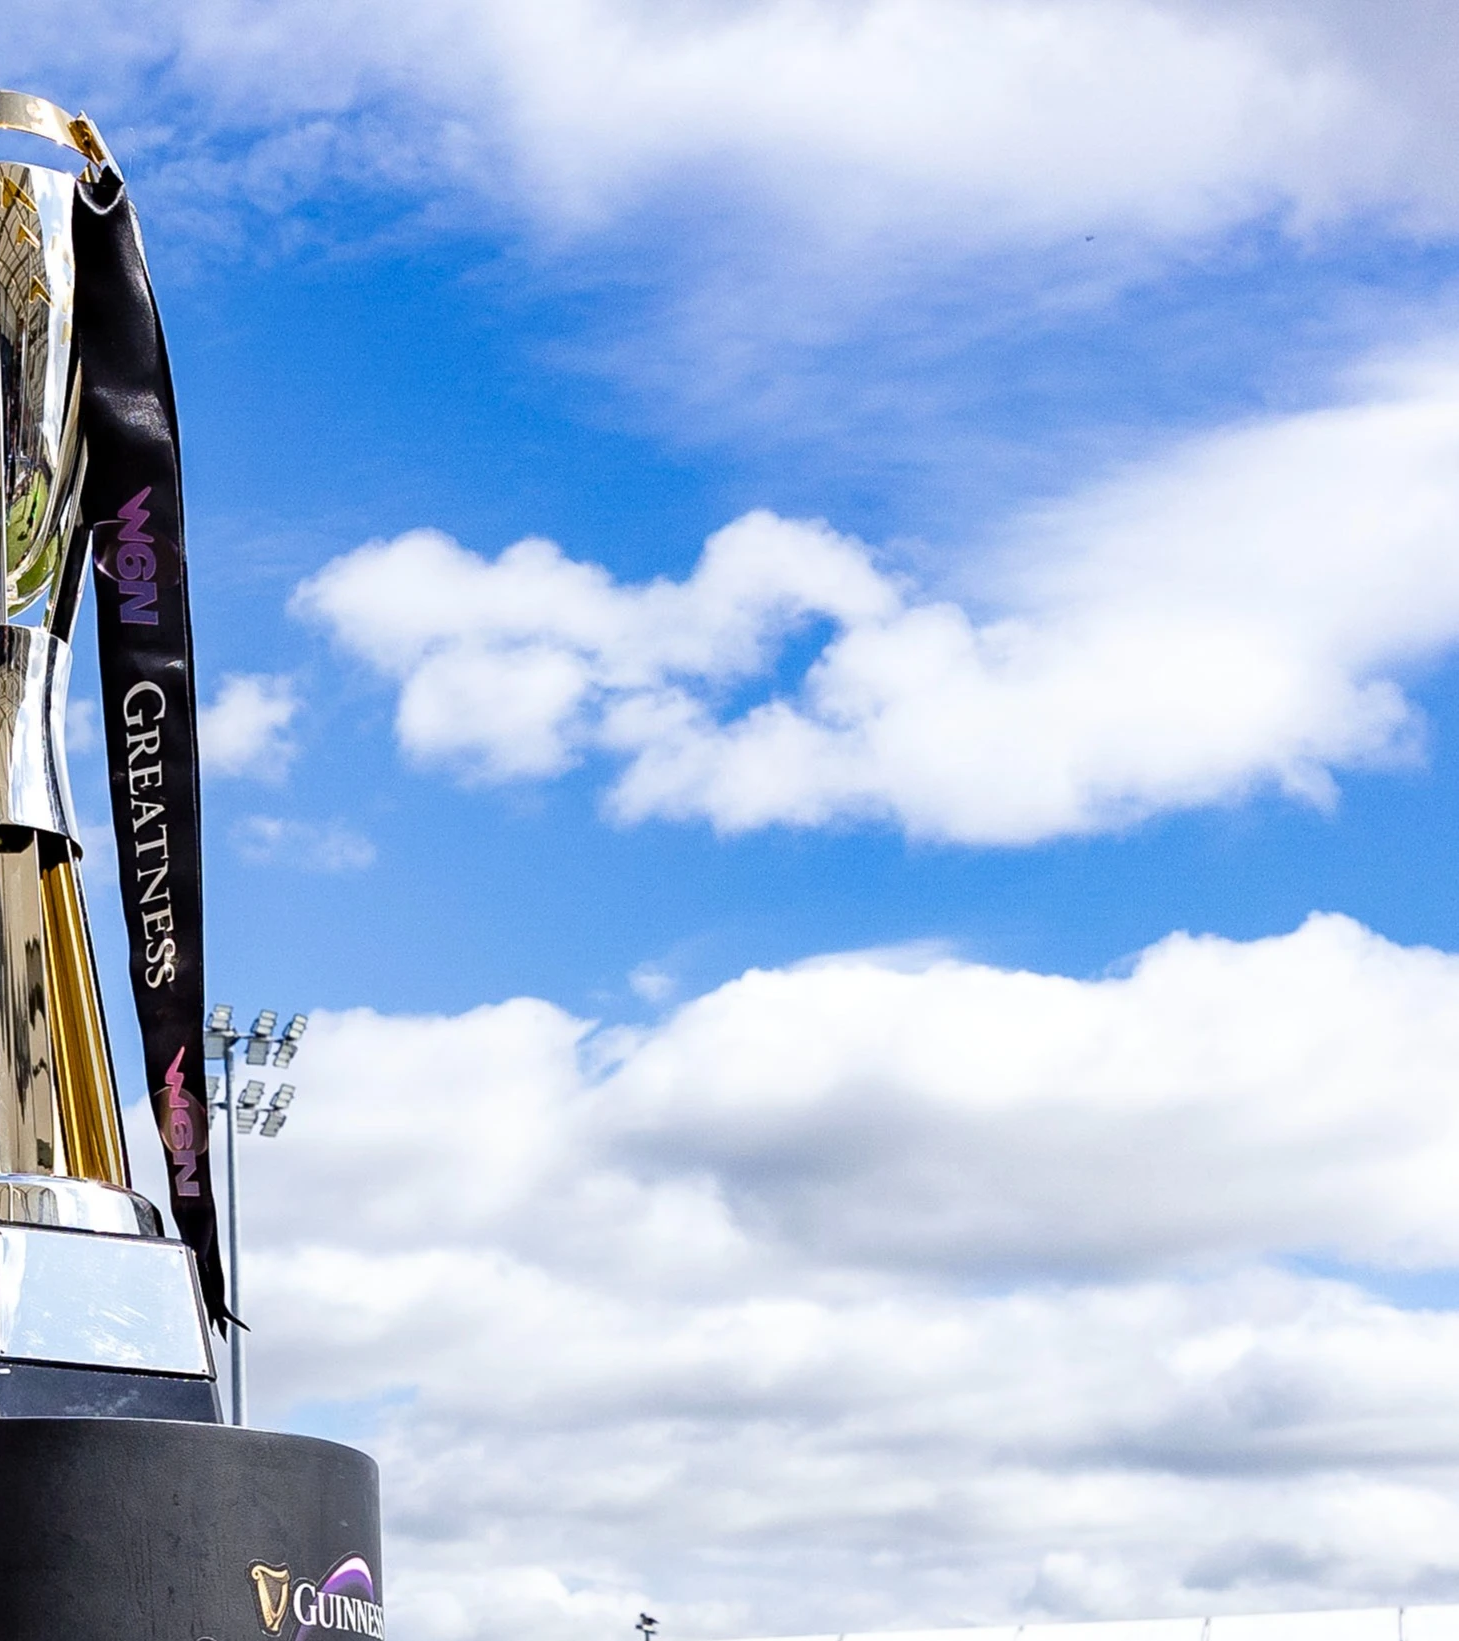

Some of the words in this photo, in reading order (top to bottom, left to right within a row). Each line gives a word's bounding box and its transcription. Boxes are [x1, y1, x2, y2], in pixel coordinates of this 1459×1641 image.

[116, 486, 159, 626] W6N
[122, 680, 176, 990] GREATNESS
[164, 1046, 201, 1197] W6N
[293, 1583, 384, 1641] GUINNESS
